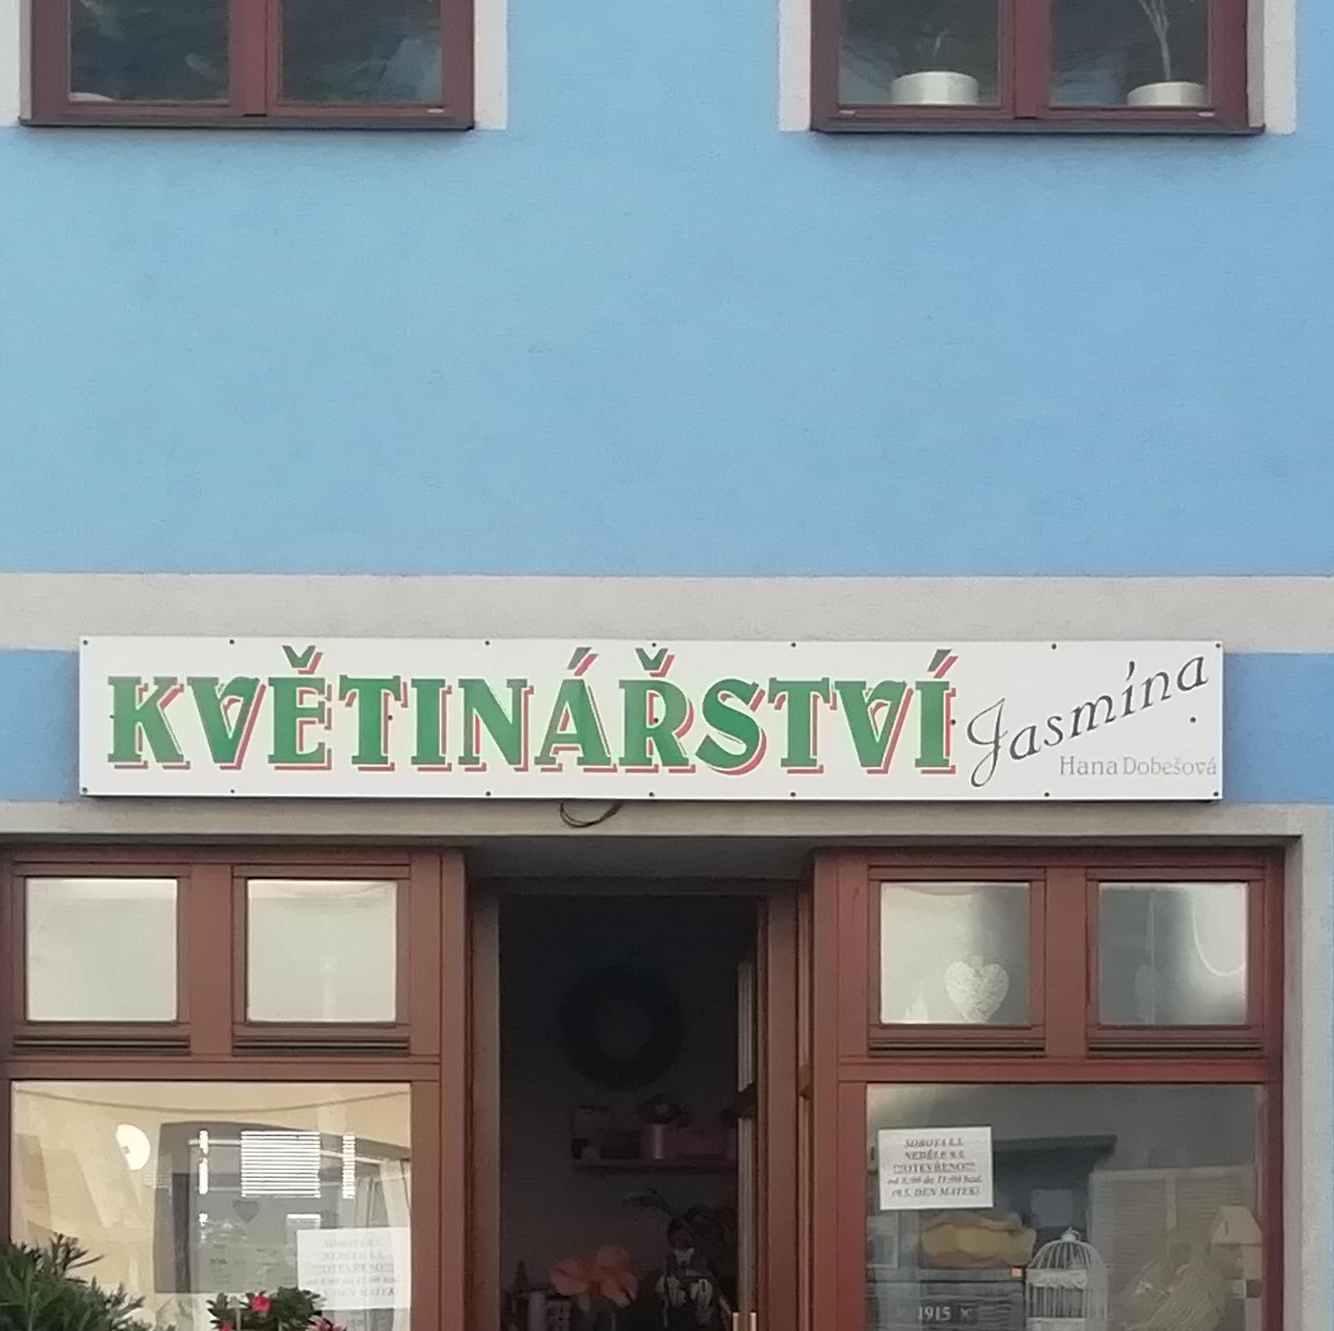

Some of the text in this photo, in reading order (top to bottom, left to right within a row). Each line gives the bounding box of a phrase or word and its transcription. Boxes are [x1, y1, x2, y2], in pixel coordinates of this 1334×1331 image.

[108, 645, 957, 777] KVĚTINÁŘSTVÍ
[967, 654, 1209, 788] Jasmína
[1059, 754, 1218, 777] Hana Dobešová
[918, 1305, 952, 1322] 1915
